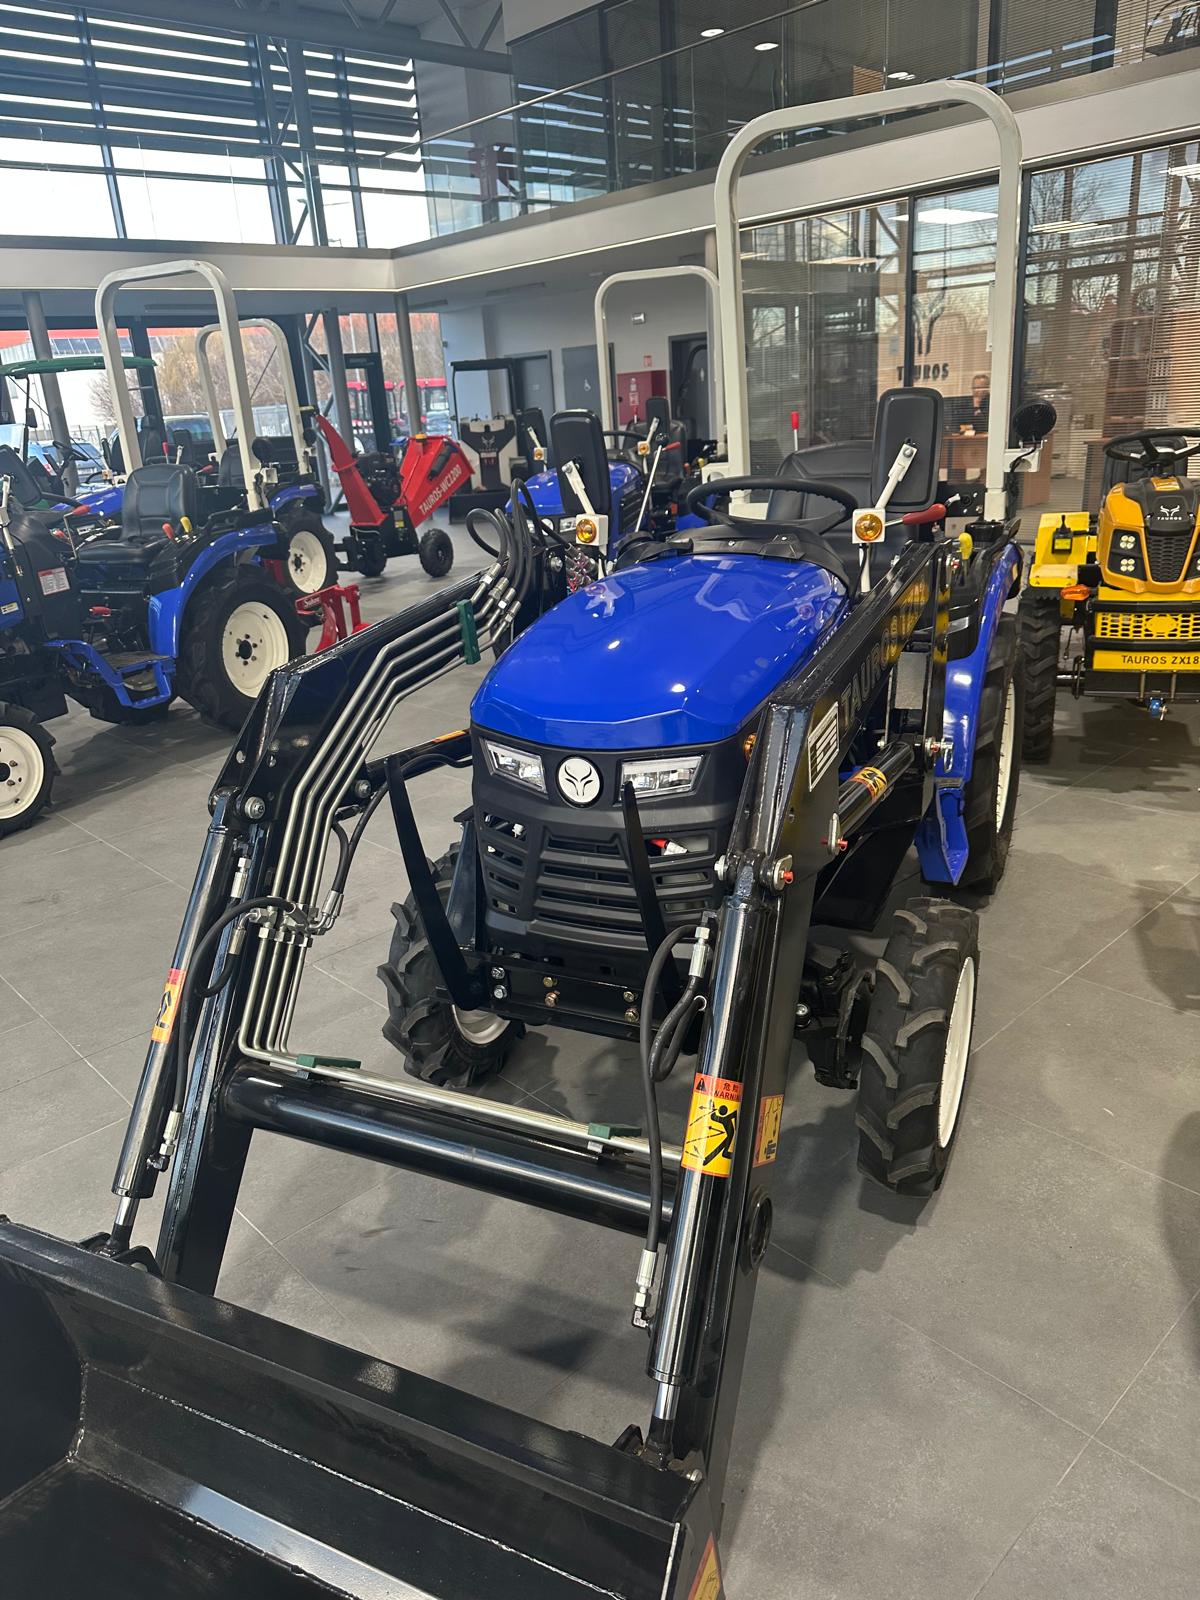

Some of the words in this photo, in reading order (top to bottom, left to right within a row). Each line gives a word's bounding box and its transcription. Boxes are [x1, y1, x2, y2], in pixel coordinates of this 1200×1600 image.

[897, 363, 949, 381] TUROS
[1121, 655, 1167, 665] TAUROS
[1171, 656, 1199, 665] ZX18
